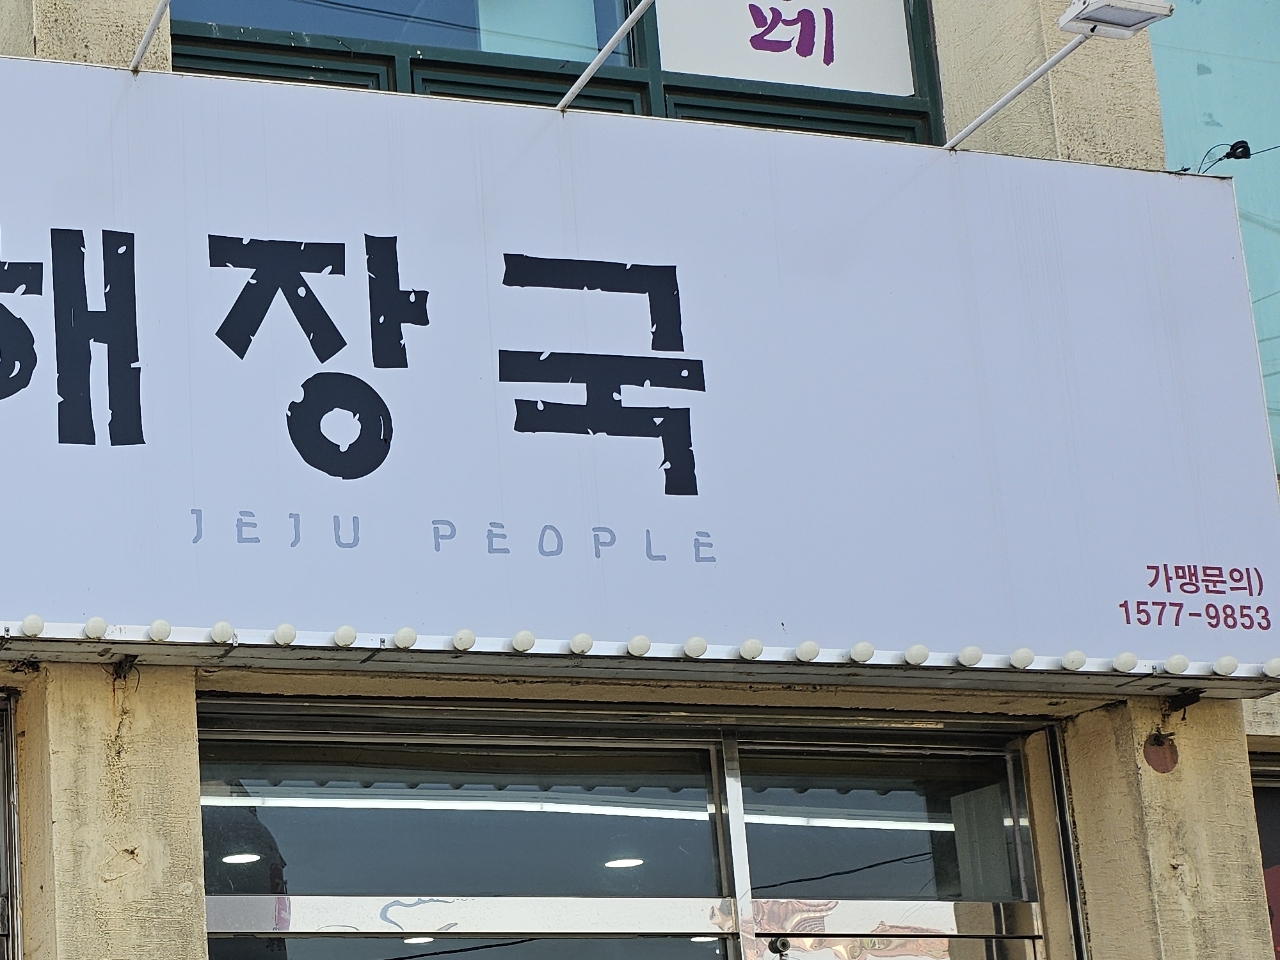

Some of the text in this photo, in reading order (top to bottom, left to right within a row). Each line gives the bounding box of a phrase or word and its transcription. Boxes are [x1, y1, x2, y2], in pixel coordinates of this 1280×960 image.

[191, 509, 718, 563] JEJU PEOPLE
[1145, 563, 1265, 597] 가맹문의)
[1119, 600, 1272, 632] 1577-9853
